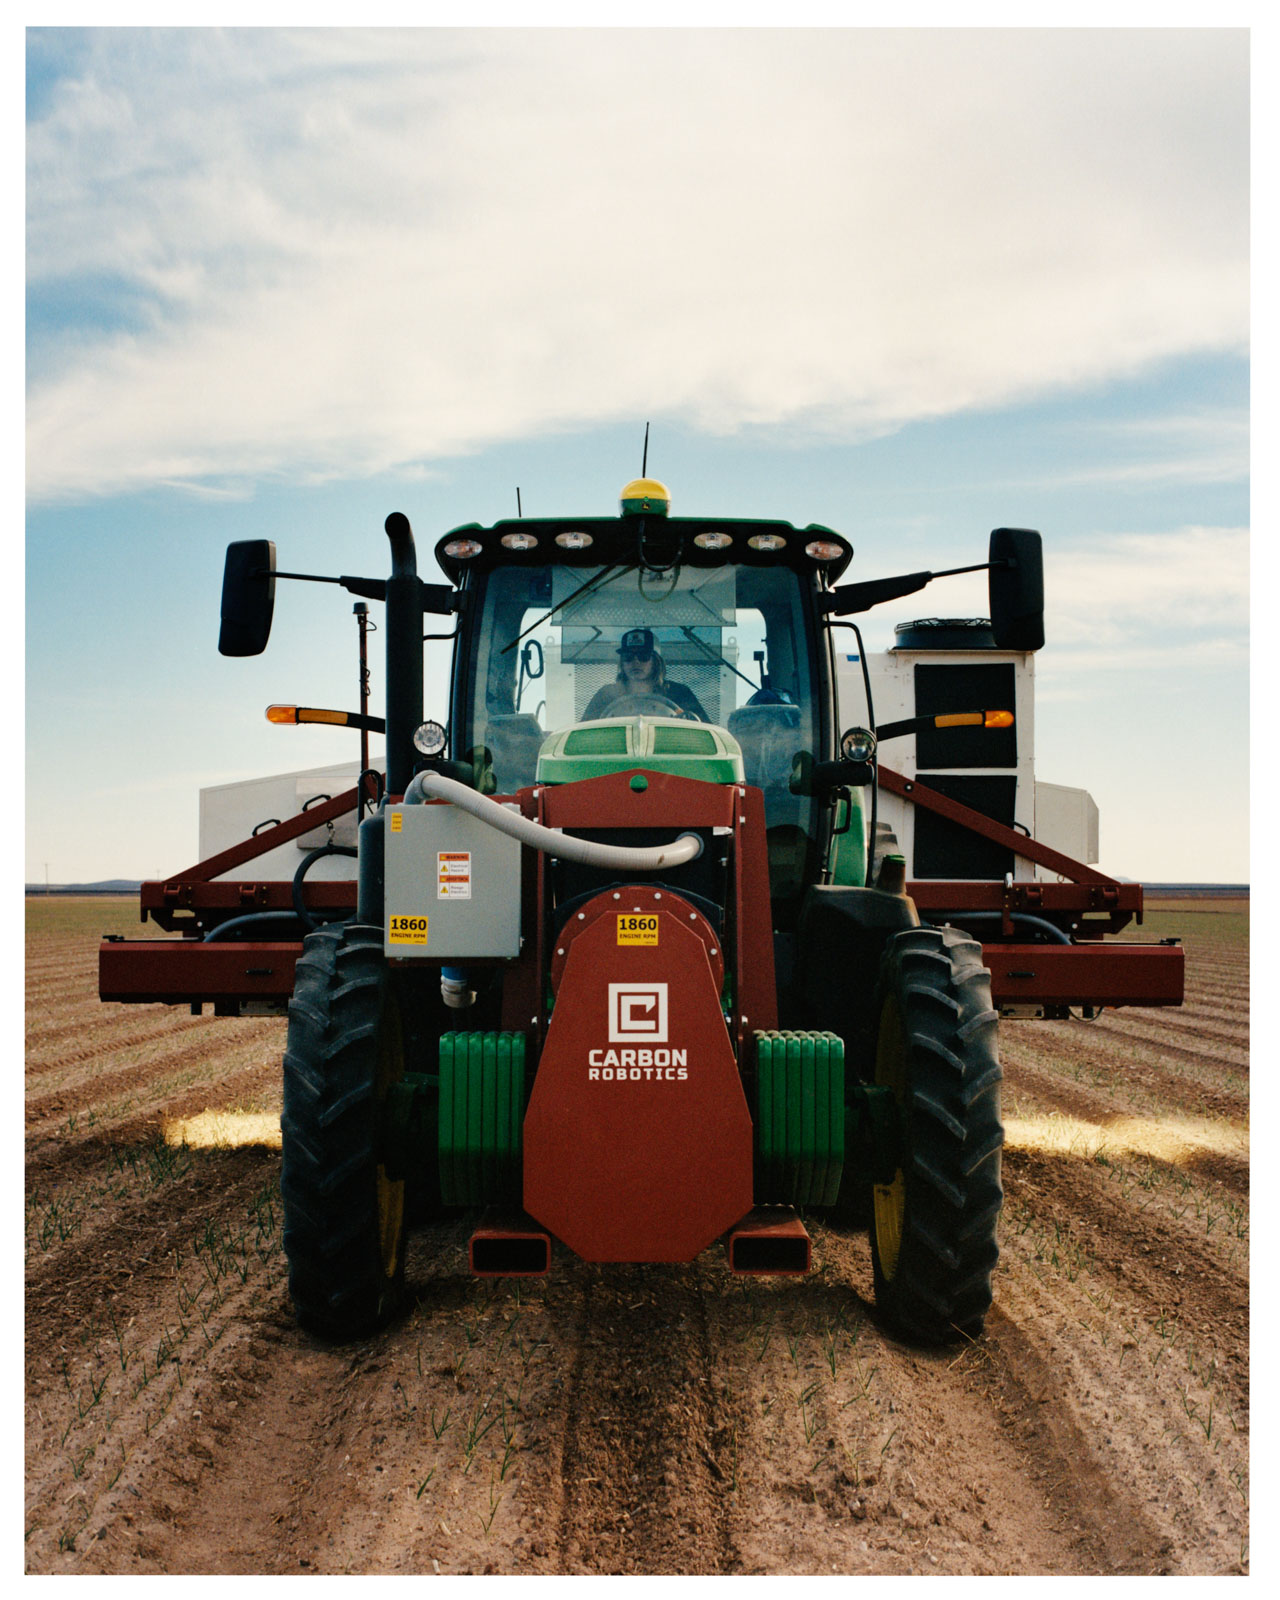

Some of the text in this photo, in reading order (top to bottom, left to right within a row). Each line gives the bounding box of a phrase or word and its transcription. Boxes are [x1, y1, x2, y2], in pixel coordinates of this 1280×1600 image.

[391, 918, 427, 931] 1860
[619, 918, 657, 930] 1860
[588, 1049, 687, 1067] CARBON
[588, 1068, 688, 1081] ROBOTICS
